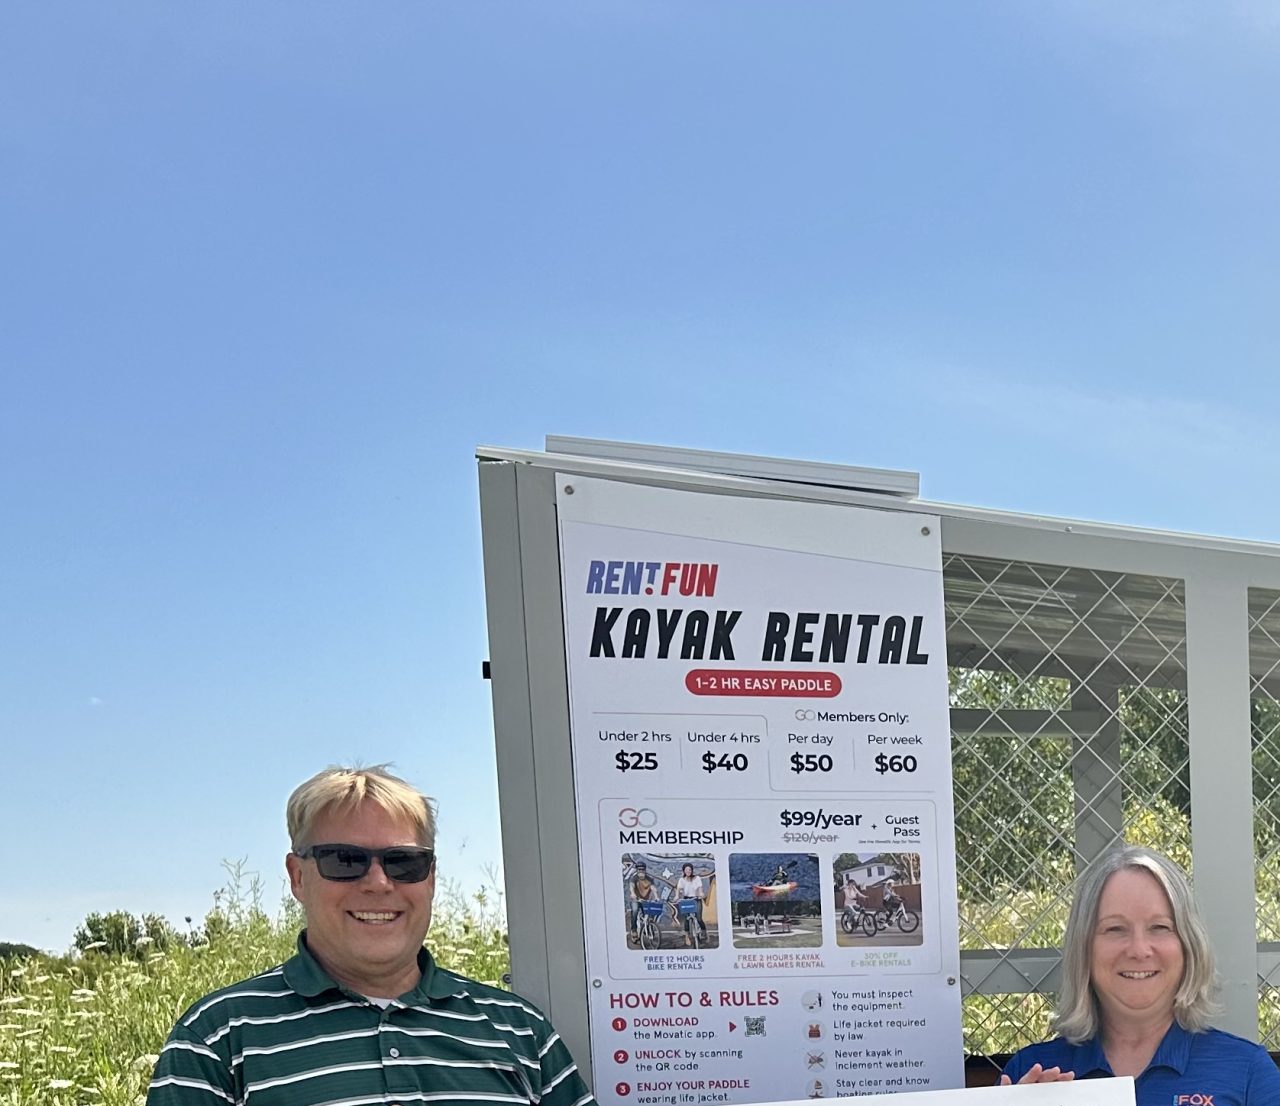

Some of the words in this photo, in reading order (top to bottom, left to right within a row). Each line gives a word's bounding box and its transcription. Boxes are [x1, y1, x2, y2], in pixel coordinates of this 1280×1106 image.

[589, 607, 742, 661] KAYAK
[761, 611, 930, 665] RENTAL
[695, 675, 718, 690] 1-2
[721, 676, 741, 690] HR
[744, 677, 777, 691] EASY
[780, 678, 832, 692] PADDLE
[817, 711, 876, 722] Members
[598, 730, 637, 742] Under
[641, 731, 649, 742] 2
[652, 731, 672, 742] hrs
[687, 732, 727, 743] Under
[729, 732, 739, 743] 4
[741, 732, 761, 743] hrs
[788, 733, 808, 744] Per
[811, 733, 834, 746] day
[868, 735, 888, 745] Per
[890, 735, 923, 745] week
[615, 749, 658, 773] $25
[702, 751, 748, 774] $40
[790, 752, 833, 774] $50
[874, 752, 917, 775] $60
[780, 809, 862, 829] $99/year
[885, 815, 919, 825] Guest
[619, 830, 744, 845] MEMBERSHIP
[893, 827, 920, 837] Pass
[783, 831, 839, 845] $120/year
[677, 955, 705, 963] HOURS
[796, 953, 820, 961] KAYAK
[647, 963, 666, 971] BIKE
[667, 963, 703, 971] RENTALS
[741, 961, 765, 969] LAWN
[795, 960, 825, 968] RENTAL
[610, 993, 659, 1009] HOW
[665, 992, 692, 1007] TO
[700, 991, 712, 1007] &
[720, 990, 779, 1007] RULES
[832, 991, 849, 999] You
[852, 990, 875, 999] must
[878, 990, 913, 999] inspect
[833, 1003, 848, 1011] the
[633, 1017, 699, 1027] DOWNLOAD
[834, 1020, 851, 1028] Life
[854, 1020, 883, 1029] jacket
[886, 1018, 926, 1029] required
[634, 1031, 650, 1039] the
[654, 1030, 692, 1039] Movatic
[835, 1033, 845, 1042] by
[635, 1050, 682, 1059] UNLOCK
[685, 1049, 696, 1060] by
[700, 1048, 743, 1059] scanning
[835, 1049, 862, 1058] Never
[866, 1048, 891, 1058] kayak
[894, 1047, 903, 1056] in
[636, 1063, 652, 1072] the
[656, 1063, 670, 1071] QR
[835, 1060, 882, 1070] inclement
[637, 1082, 672, 1091] ENJOY
[676, 1081, 705, 1090] YOUR
[708, 1080, 750, 1089] PADDLE
[836, 1079, 856, 1088] Stay
[859, 1078, 882, 1087] clear
[886, 1077, 902, 1086] and
[905, 1076, 930, 1085] know
[638, 1095, 676, 1104] wearing
[680, 1093, 695, 1102] life
